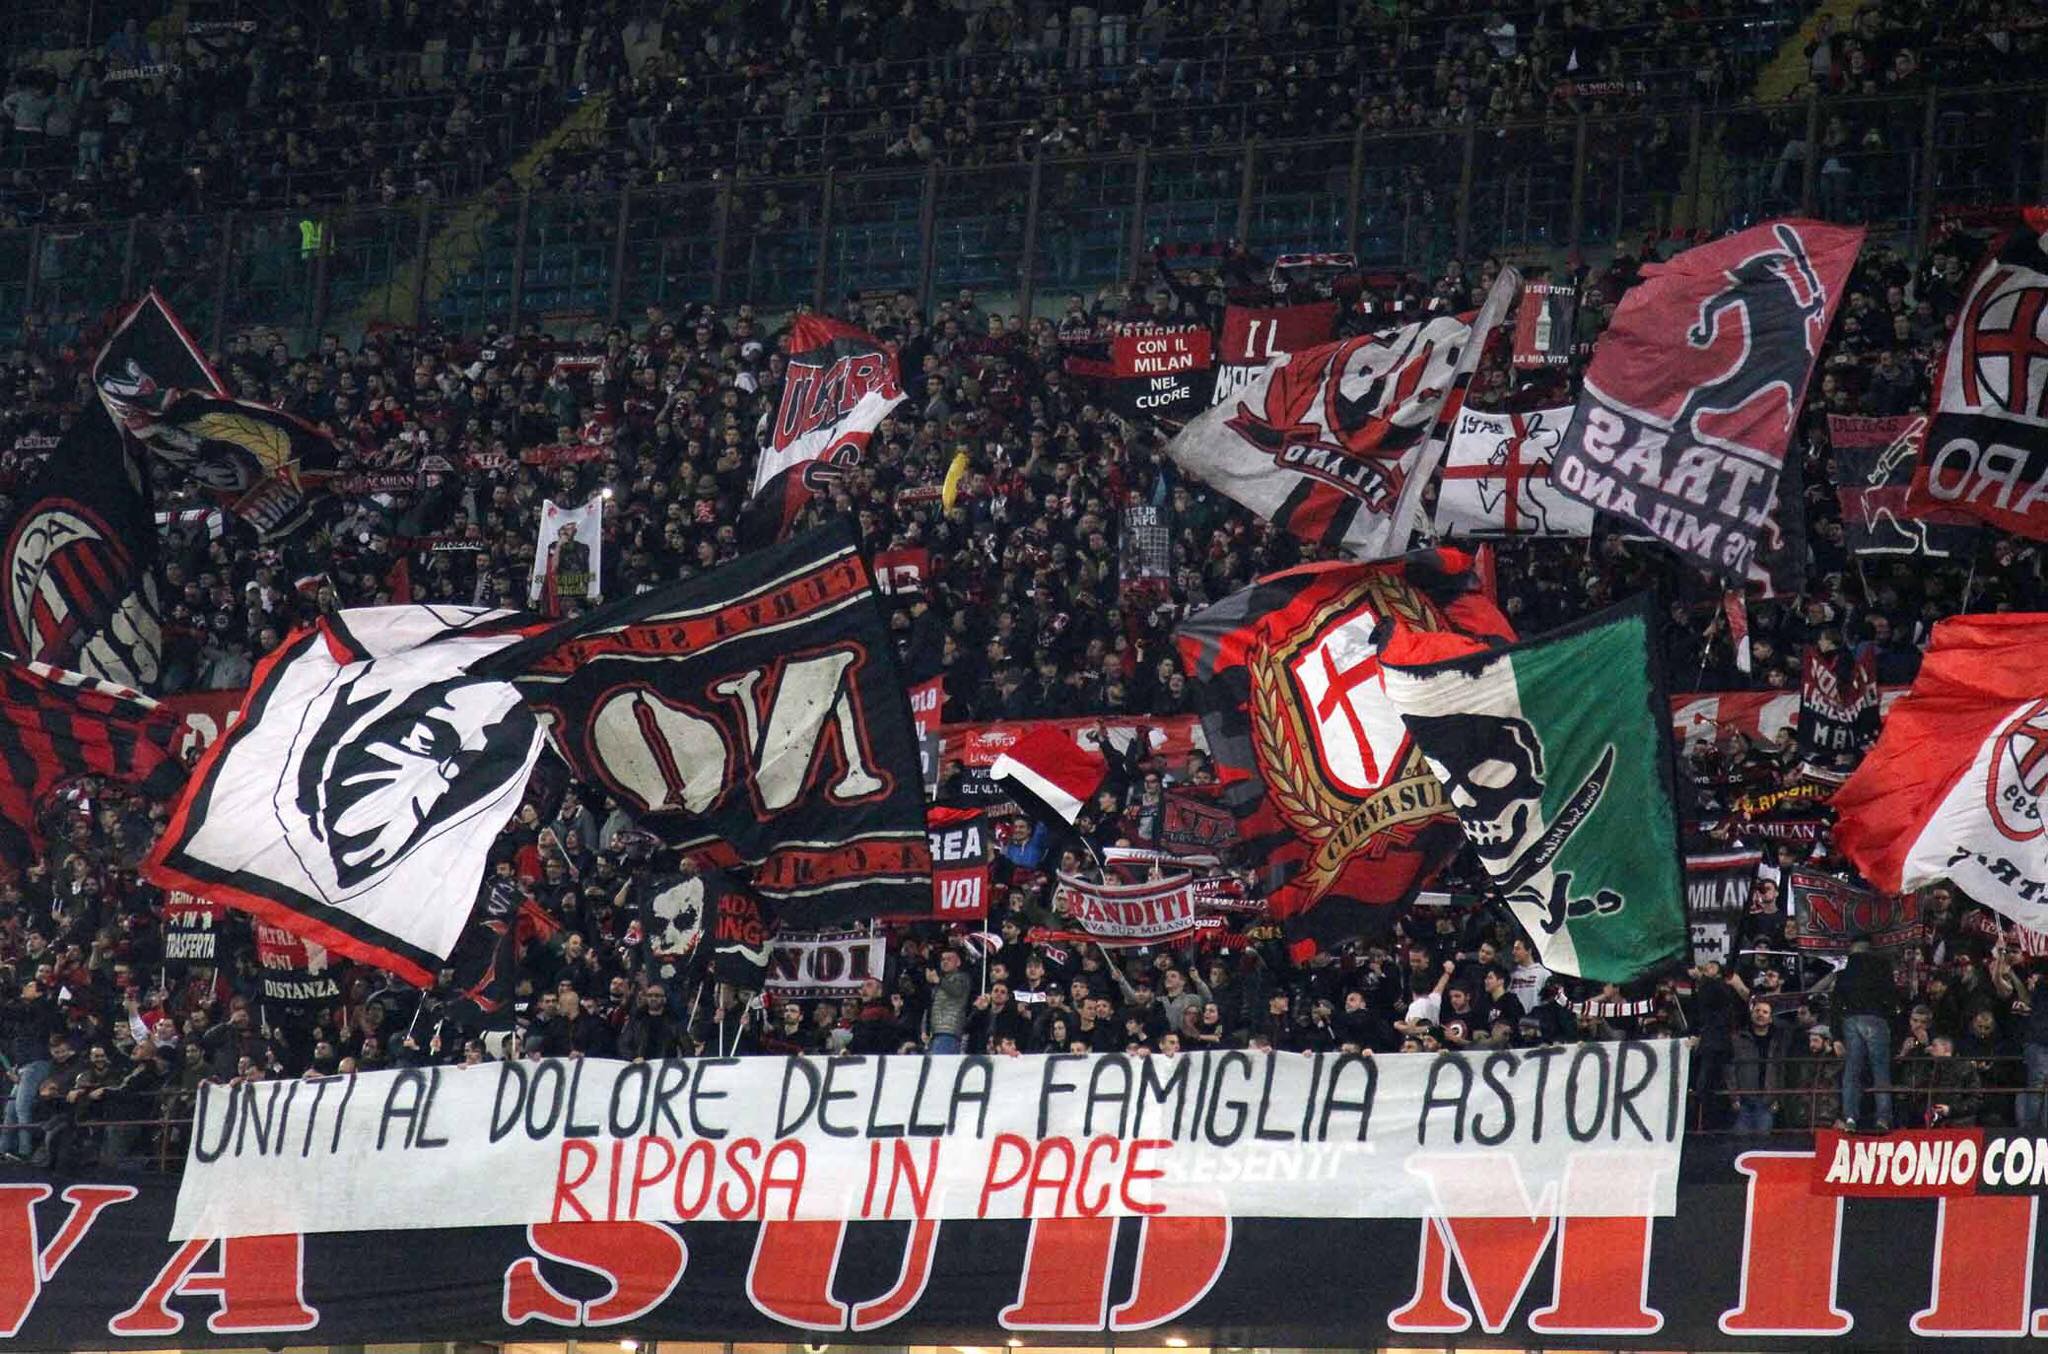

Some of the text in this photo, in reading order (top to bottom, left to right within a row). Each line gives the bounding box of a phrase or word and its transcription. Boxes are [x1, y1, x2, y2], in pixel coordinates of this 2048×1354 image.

[1137, 337, 1188, 354] CON IL
[1244, 319, 1285, 358] IL
[1134, 353, 1193, 373] MILAN
[1513, 355, 1569, 364] LA MIA VITA
[1150, 375, 1178, 391] NEL
[1136, 387, 1190, 410] CUORE
[1327, 795, 1398, 861] CURVA
[1758, 823, 1816, 839] MILAN
[940, 877, 982, 910] VOI
[182, 910, 196, 928] IN
[1066, 890, 1192, 926] BANDITI
[1111, 924, 1136, 936] SUD
[1141, 917, 1194, 935] MILANO
[166, 933, 216, 959] TRASFERTA
[261, 951, 293, 971] OGNI
[264, 978, 340, 1000] DISTANZA
[195, 1039, 1680, 1164] UNITI AL DOLORE DELLA FAMIGLIA ASTORI
[1825, 1138, 1977, 1186] ANTONIO
[551, 1132, 1174, 1222] RIPOSA IN PACE
[502, 1205, 1233, 1332] SUD
